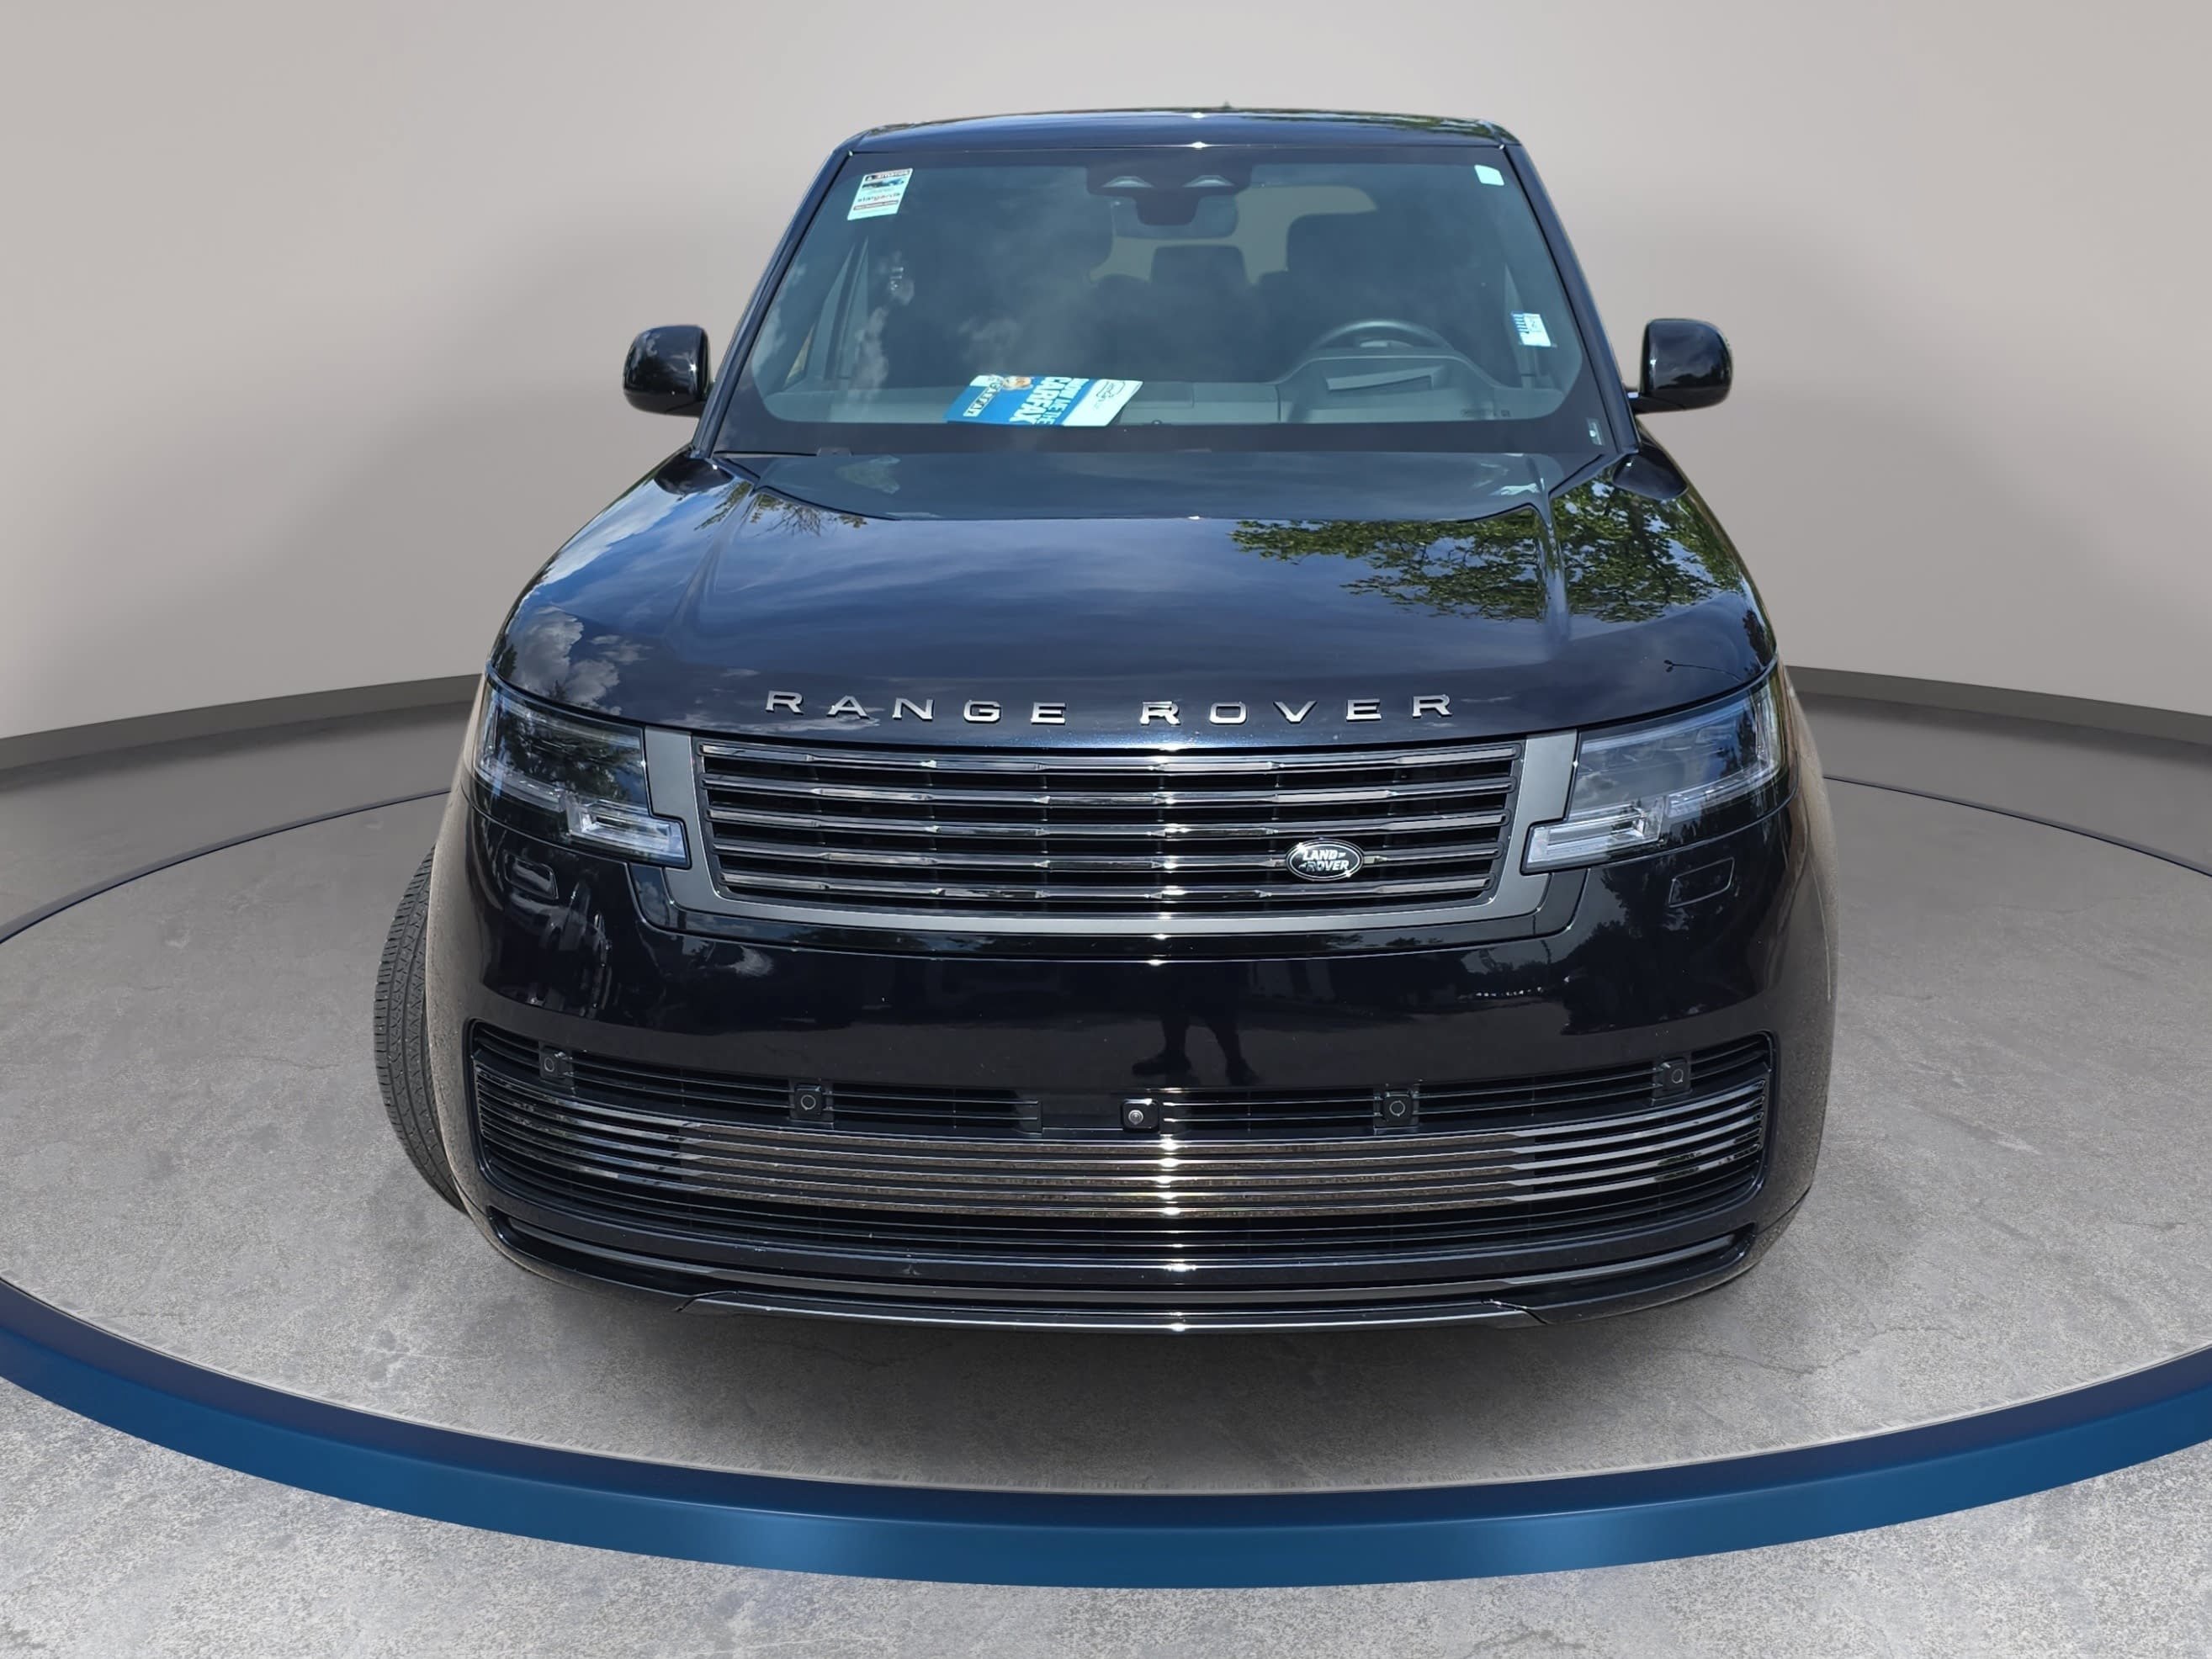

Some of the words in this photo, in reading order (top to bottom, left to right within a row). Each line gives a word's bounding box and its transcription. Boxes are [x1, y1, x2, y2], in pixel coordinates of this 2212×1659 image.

[1009, 377, 1072, 424] CARFAX
[1048, 399, 1071, 411] ME
[1036, 411, 1063, 425] THE
[766, 690, 1066, 725] RANGE
[1140, 694, 1453, 725] ROVER
[1302, 849, 1338, 861] LAND
[1306, 860, 1350, 872] ROVER
